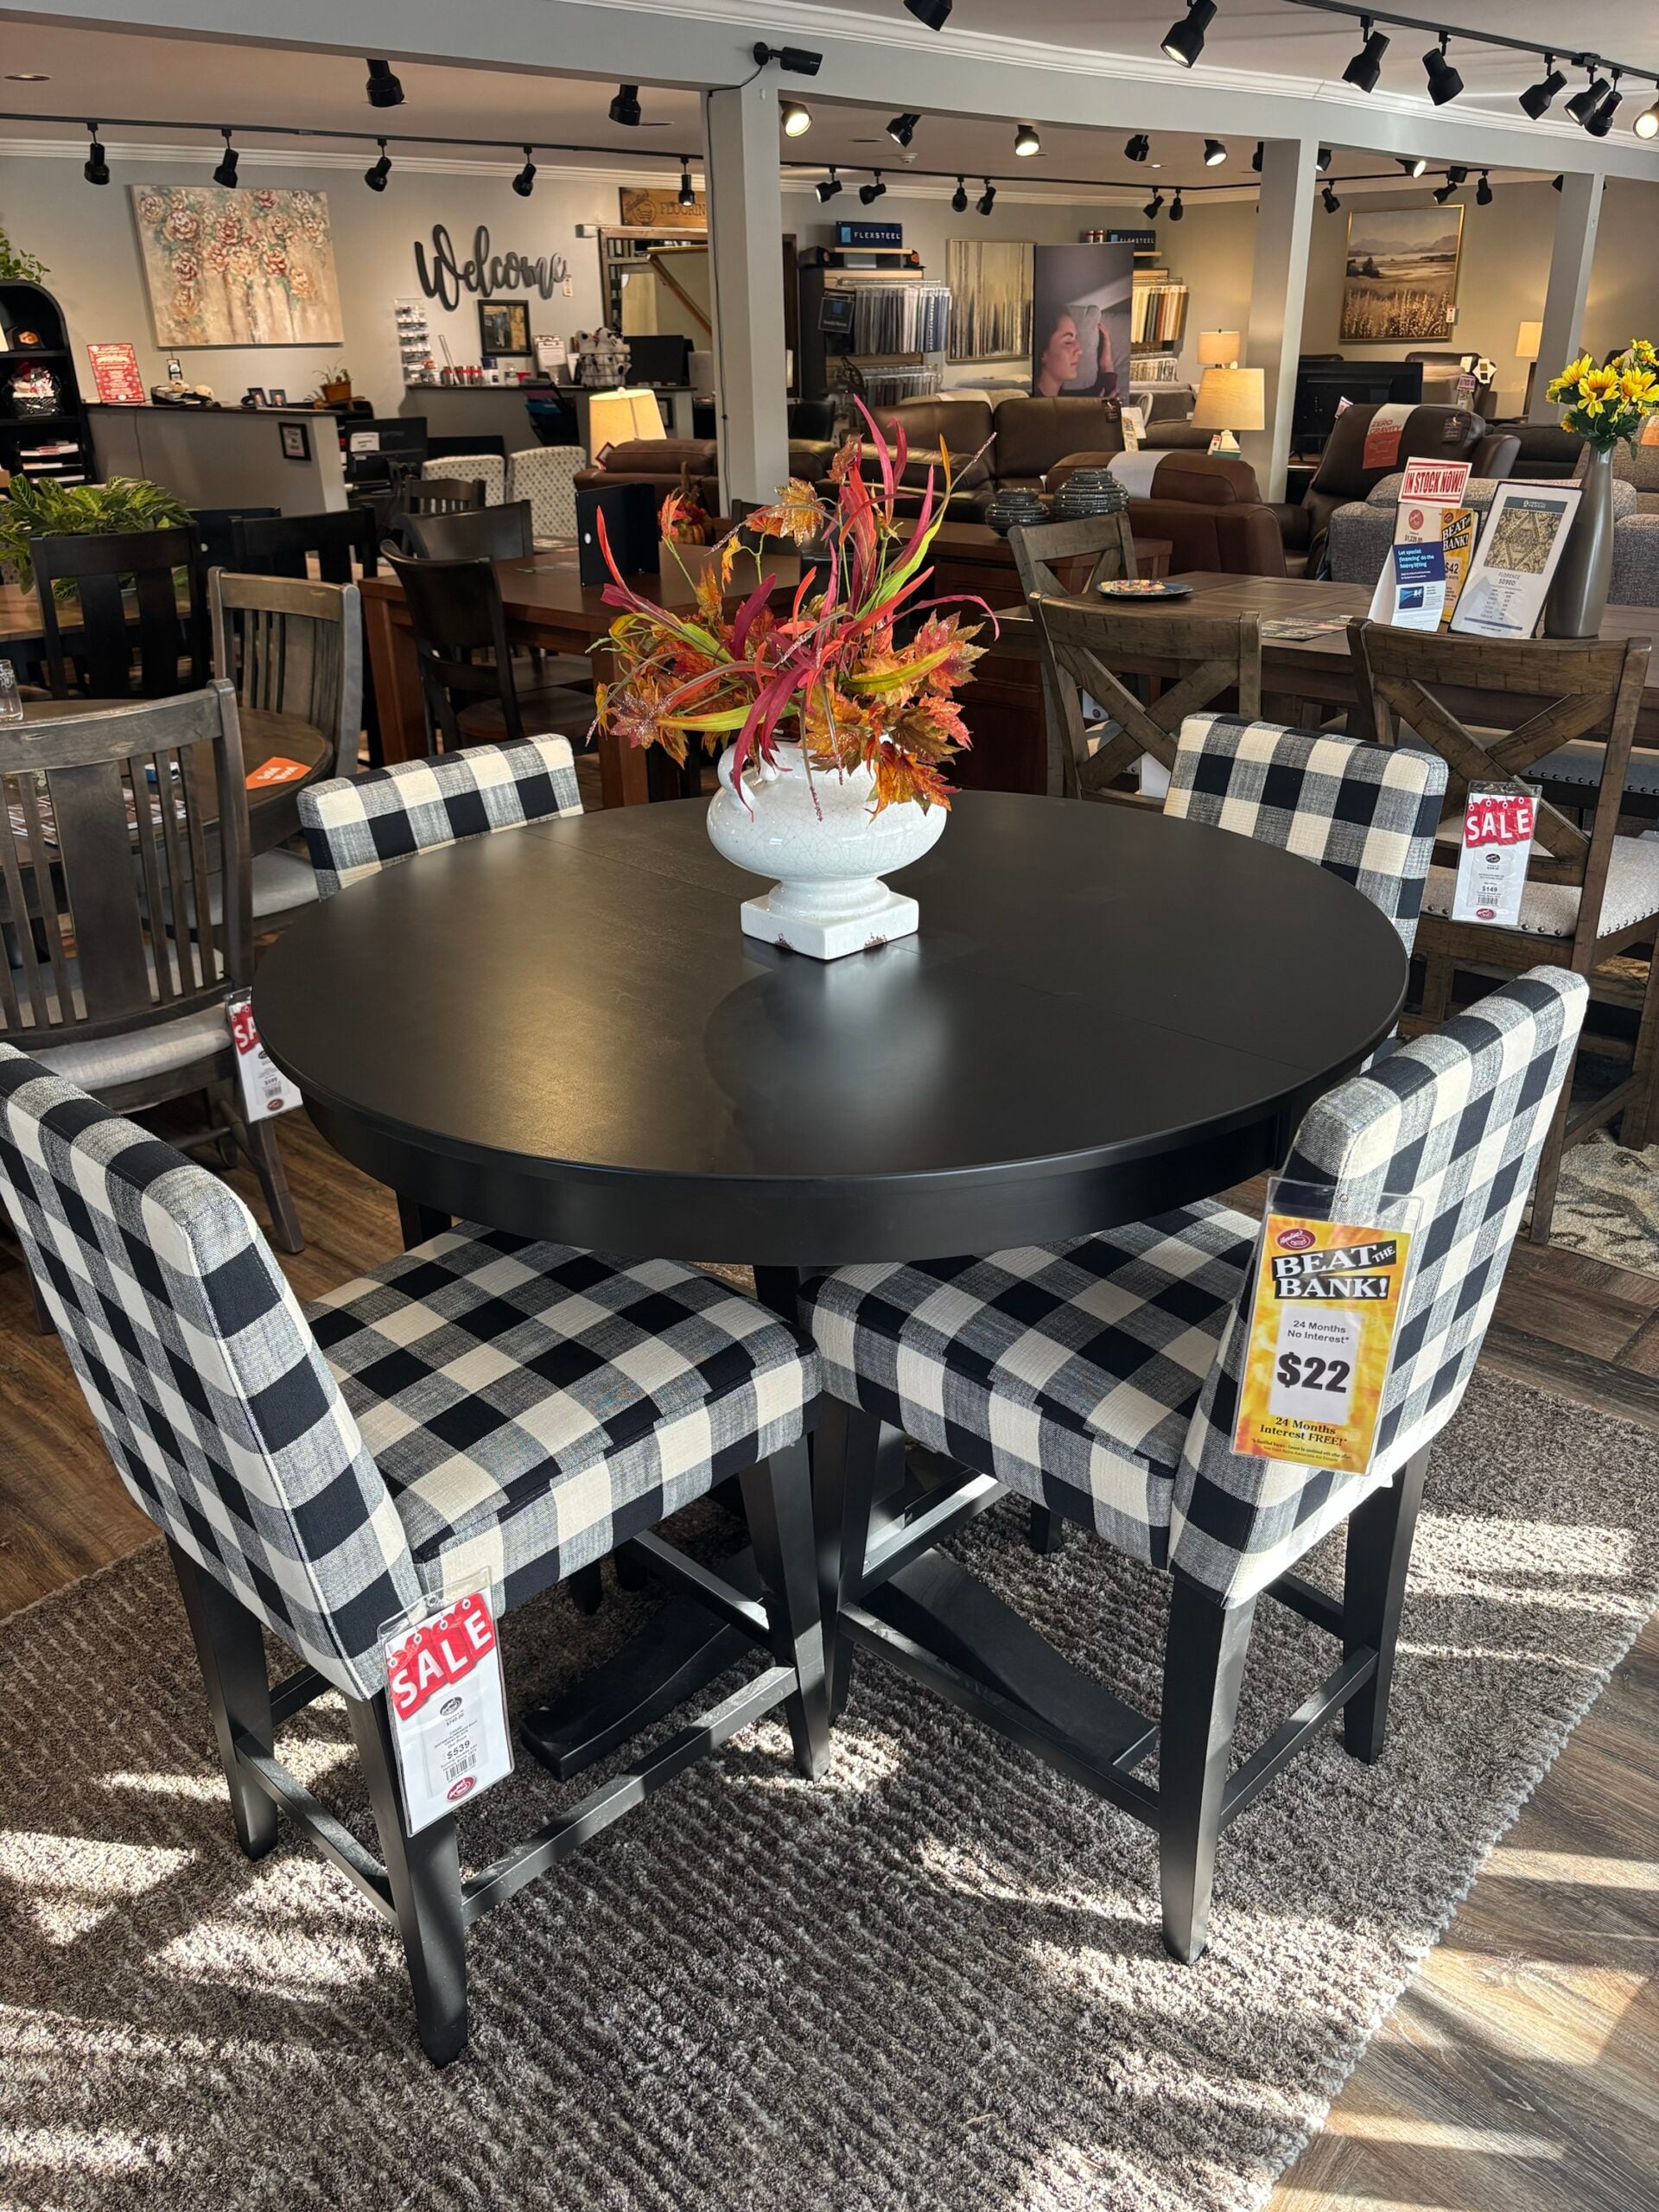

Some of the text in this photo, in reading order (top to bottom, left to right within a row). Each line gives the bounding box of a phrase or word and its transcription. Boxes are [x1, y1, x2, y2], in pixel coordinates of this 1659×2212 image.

[659, 201, 706, 216] FLOORIN
[415, 225, 566, 312] Welcome
[1404, 470, 1465, 493] IN STOCK NOW!
[1442, 517, 1467, 540] BEAT
[1443, 535, 1469, 551] BANK!
[1466, 809, 1530, 841] SALE
[234, 1016, 257, 1048] SA
[1274, 1245, 1395, 1277] BEAT THE
[1279, 1278, 1388, 1298] BANK!
[1287, 1330, 1301, 1338] No
[1308, 1322, 1346, 1333] Months
[1277, 1351, 1351, 1394] $22
[1260, 1424, 1306, 1440] Interest
[1275, 1417, 1336, 1434] 24 Months
[392, 1609, 493, 1709] SALE
[447, 1740, 470, 1759] $539
